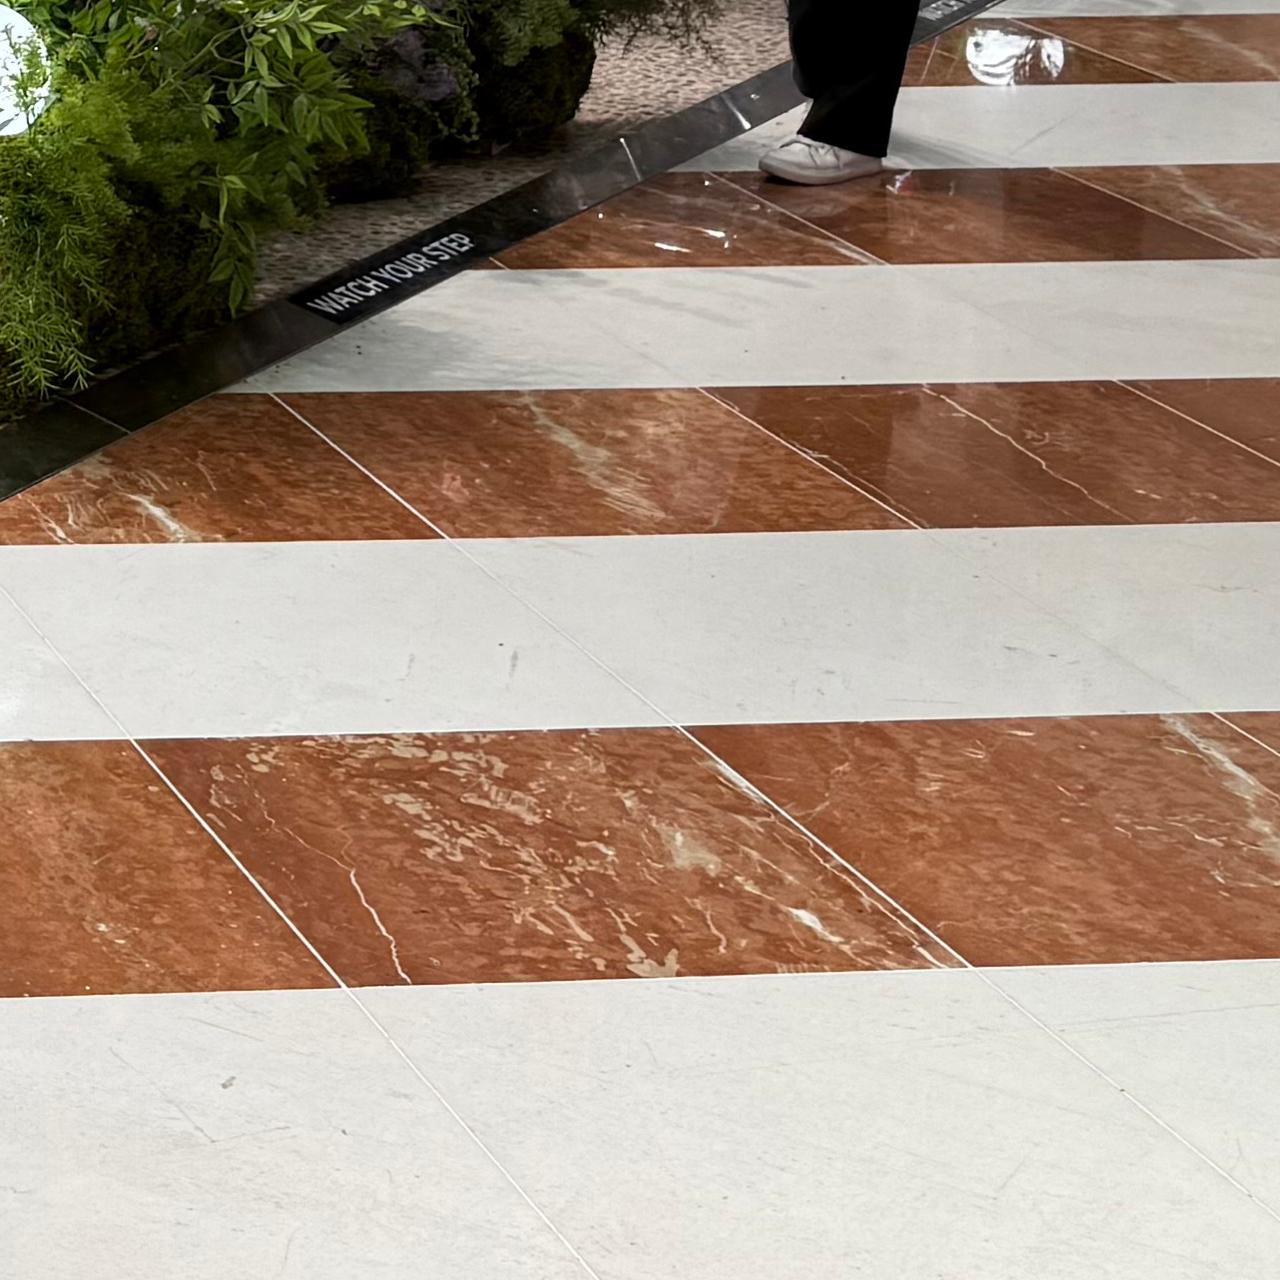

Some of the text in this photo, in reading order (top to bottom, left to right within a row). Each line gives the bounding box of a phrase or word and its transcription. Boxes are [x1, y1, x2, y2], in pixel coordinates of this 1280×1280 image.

[306, 232, 476, 315] WATCH YOUR STEP
